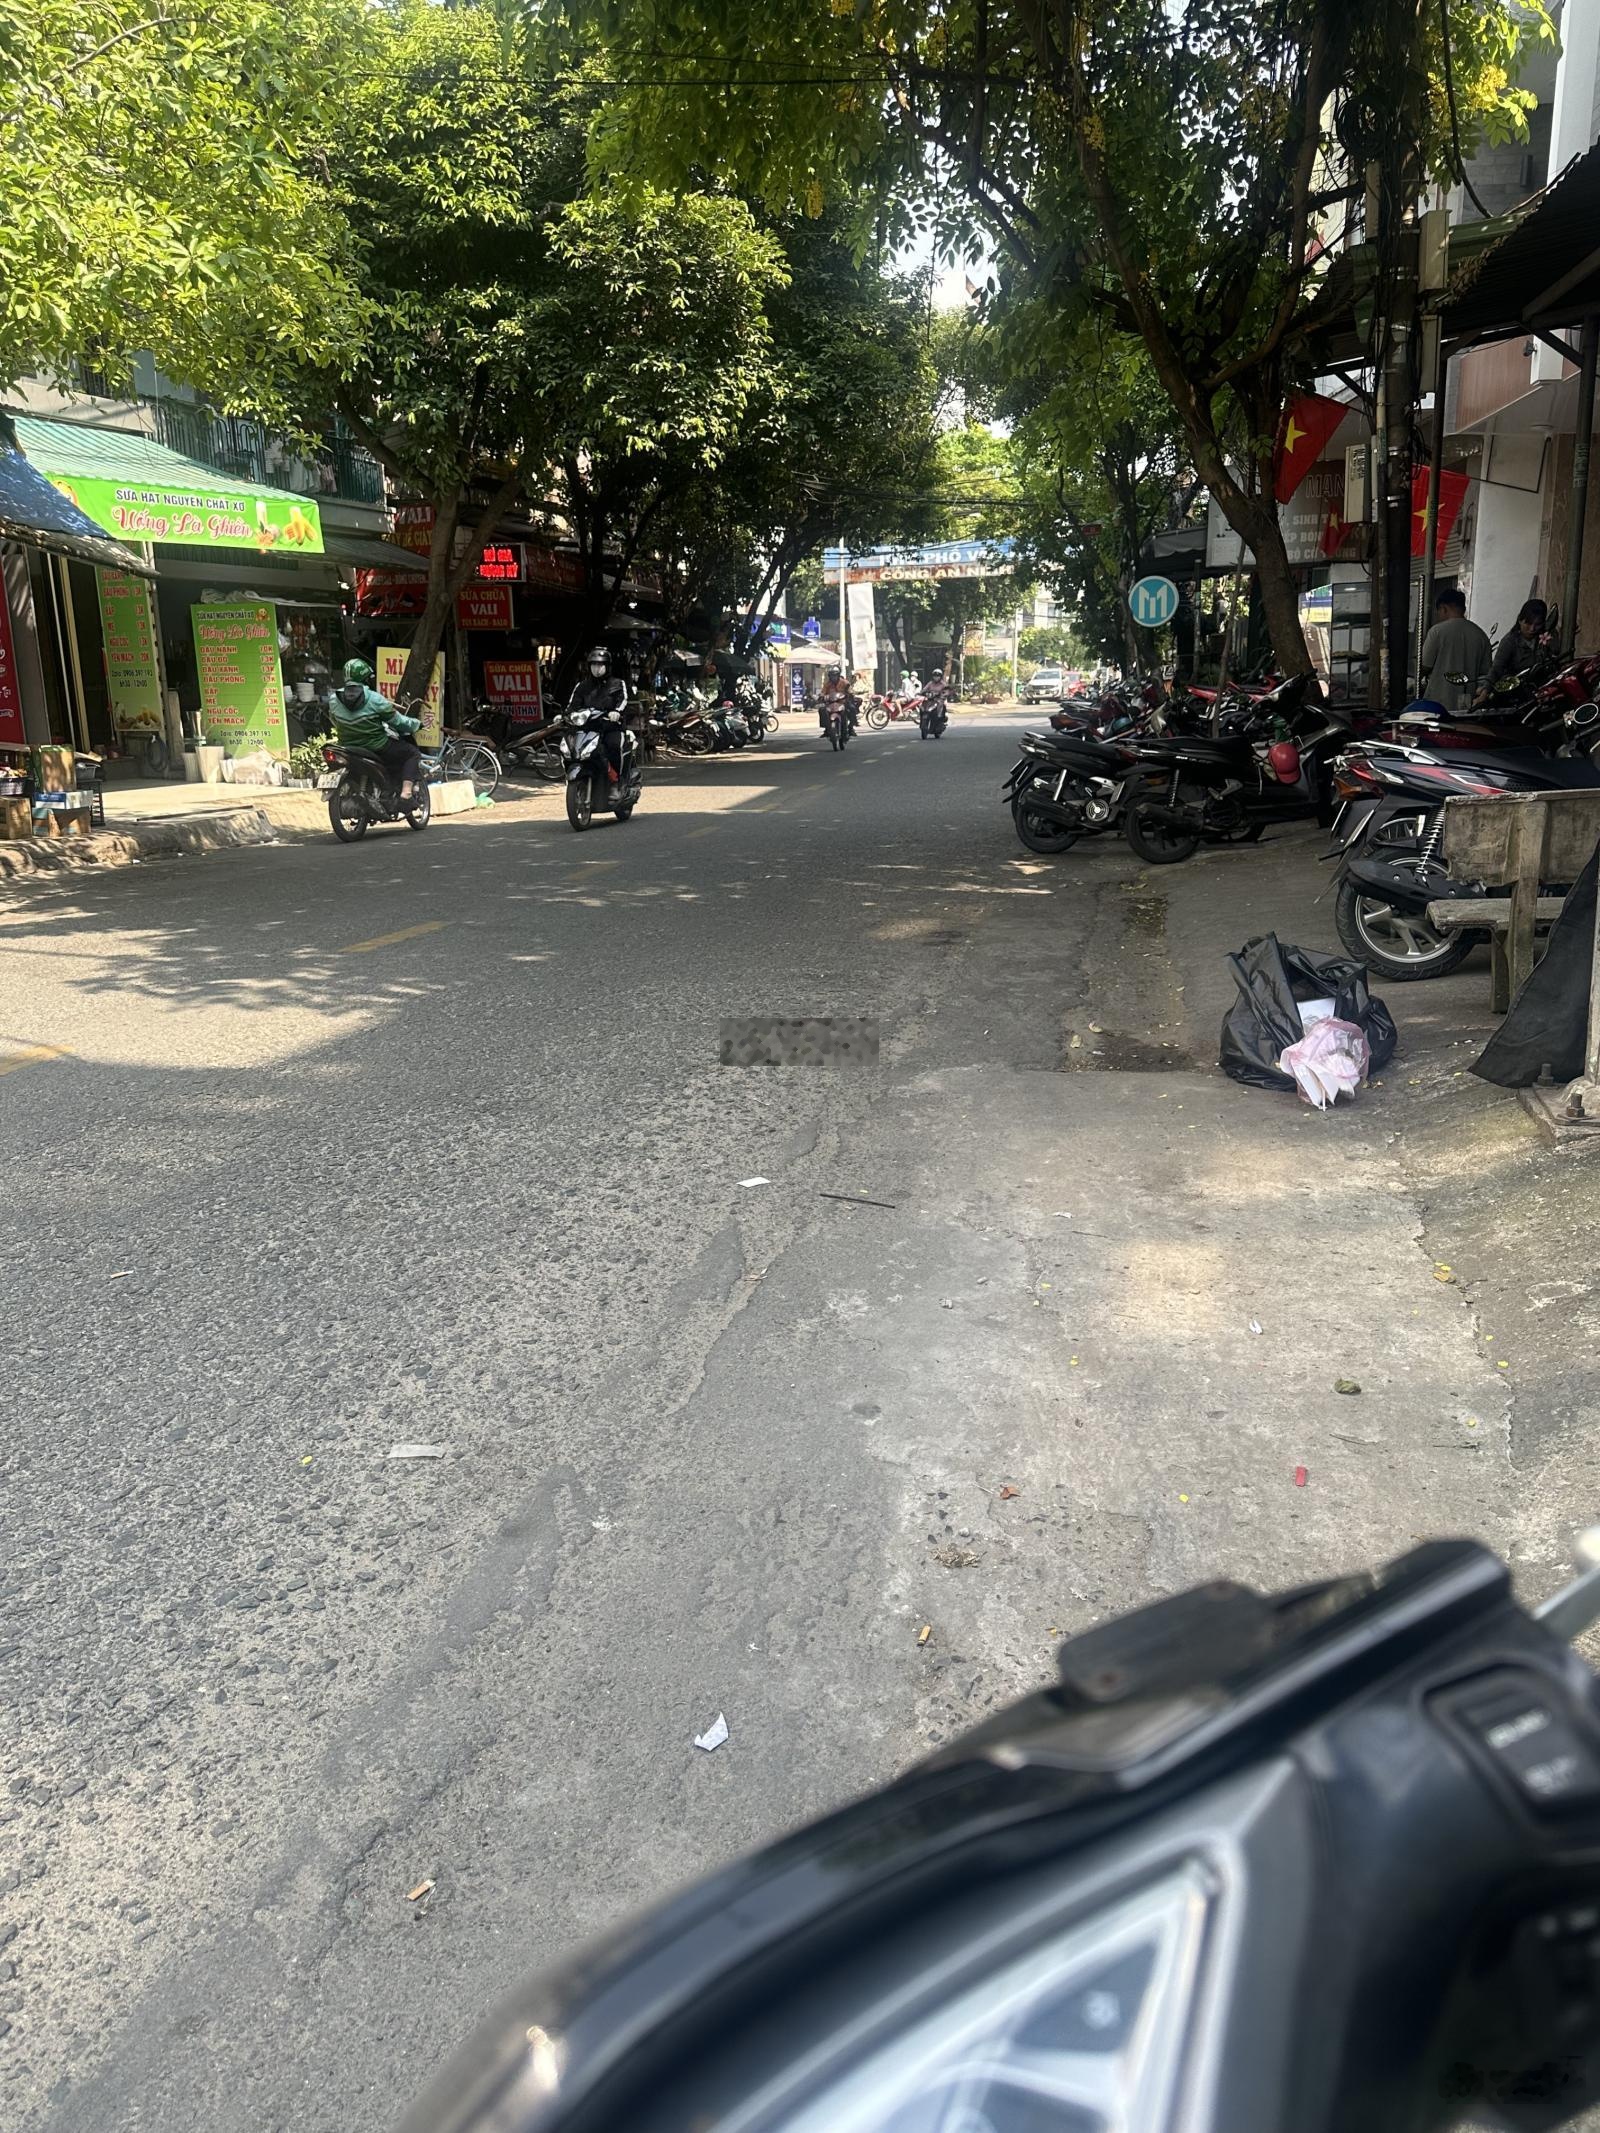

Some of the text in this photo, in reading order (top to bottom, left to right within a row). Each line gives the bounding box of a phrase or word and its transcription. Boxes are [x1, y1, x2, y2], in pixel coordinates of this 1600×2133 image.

[470, 603, 498, 615] VALI
[385, 654, 403, 676] MÌ
[492, 674, 532, 691] VALI
